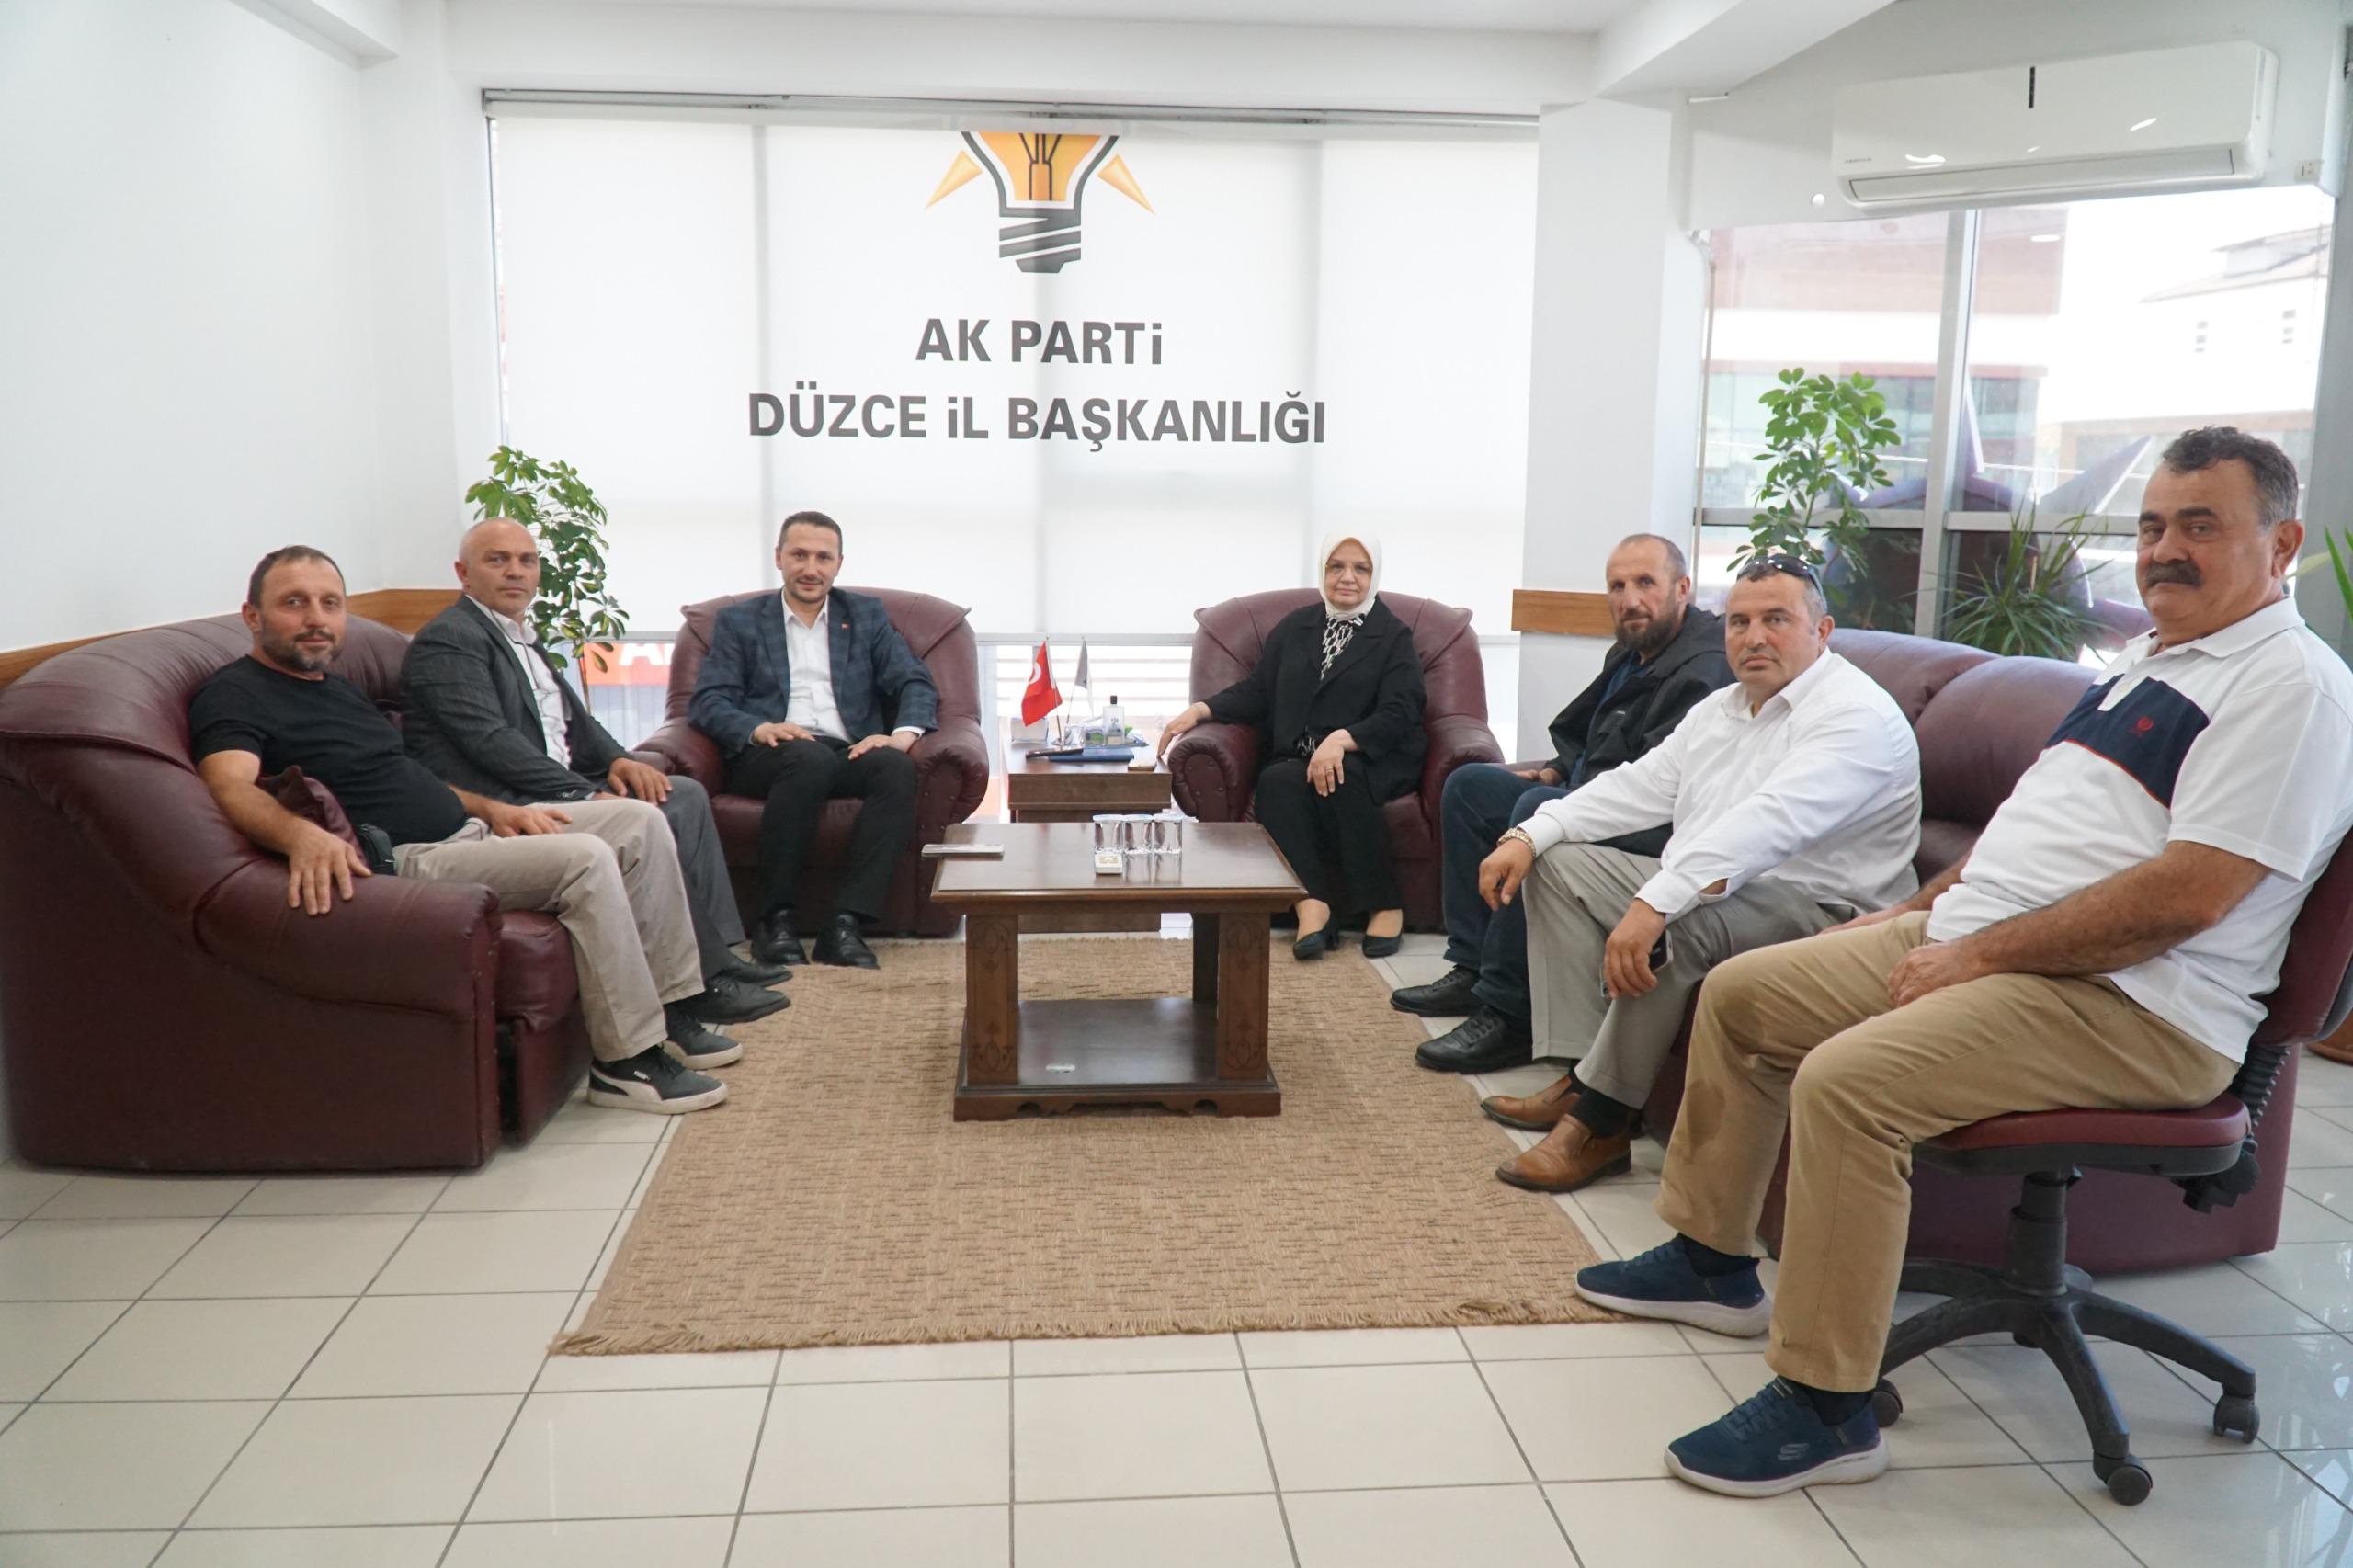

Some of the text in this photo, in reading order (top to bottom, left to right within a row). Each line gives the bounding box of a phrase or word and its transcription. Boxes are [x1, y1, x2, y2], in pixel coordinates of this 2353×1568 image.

[915, 318, 992, 362] AK
[748, 381, 926, 438] DÜZCE
[1008, 390, 1325, 453] BAŞKANLIĞI
